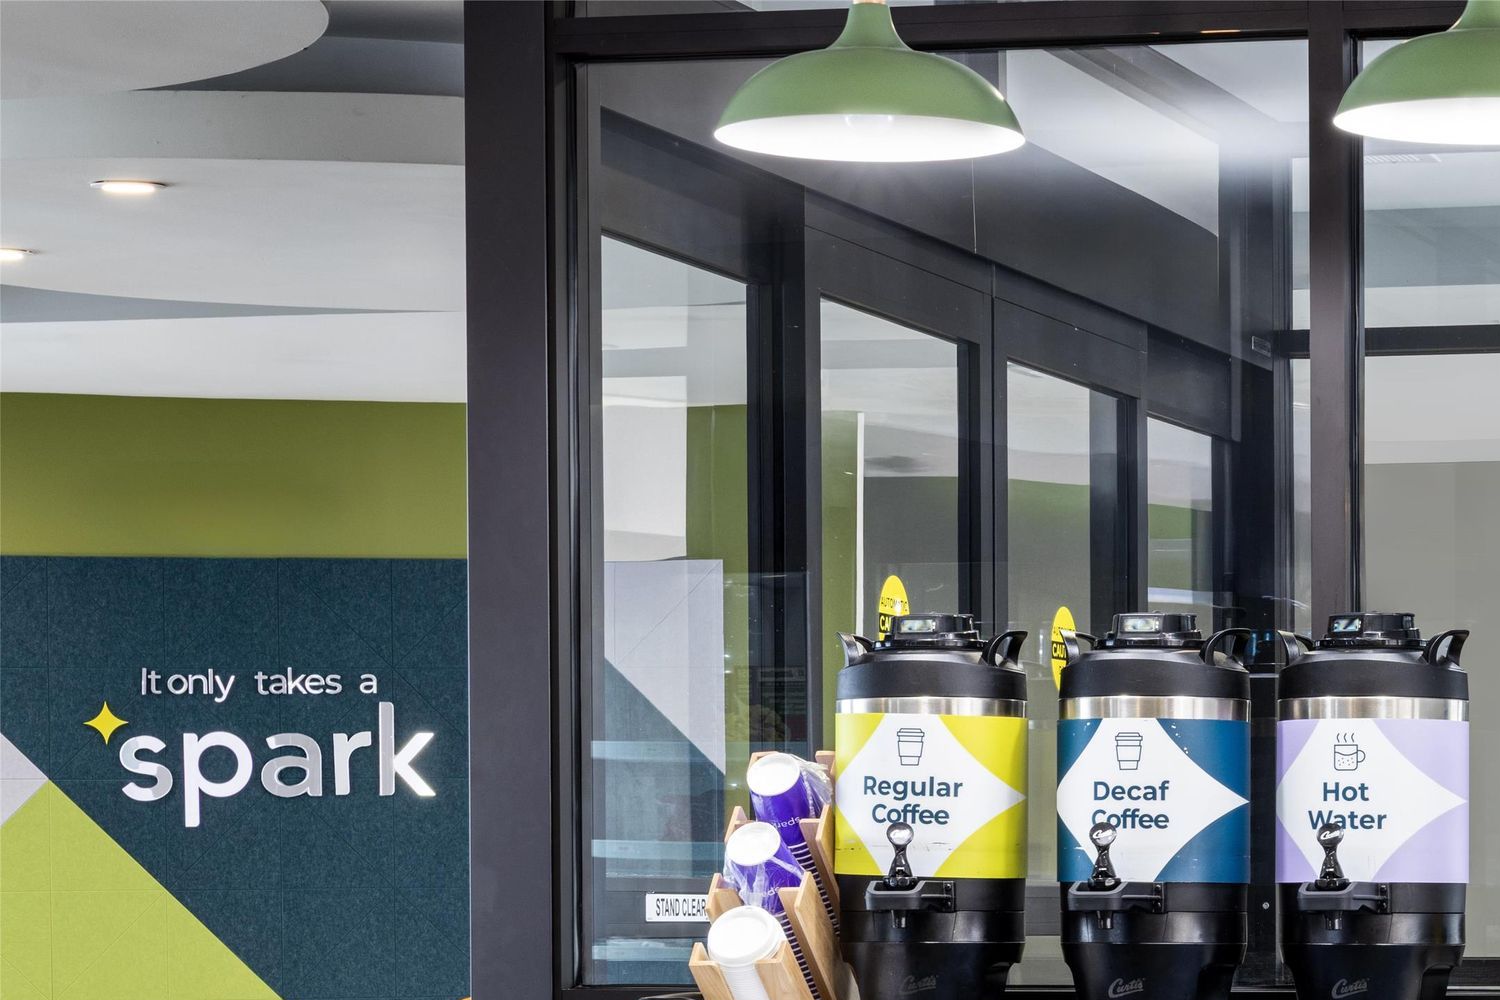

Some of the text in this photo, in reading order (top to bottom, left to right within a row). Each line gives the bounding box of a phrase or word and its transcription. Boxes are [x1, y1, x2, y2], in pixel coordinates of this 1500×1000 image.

[141, 667, 378, 703] It only takes a
[119, 701, 436, 828] spark
[863, 775, 963, 801] Regular
[1093, 780, 1170, 801] Decaf
[1322, 782, 1370, 802] Hot
[871, 803, 950, 825] Coffee
[1091, 808, 1170, 829] Coffee
[1307, 810, 1387, 830] Water
[655, 898, 707, 917] STAND CLEAR
